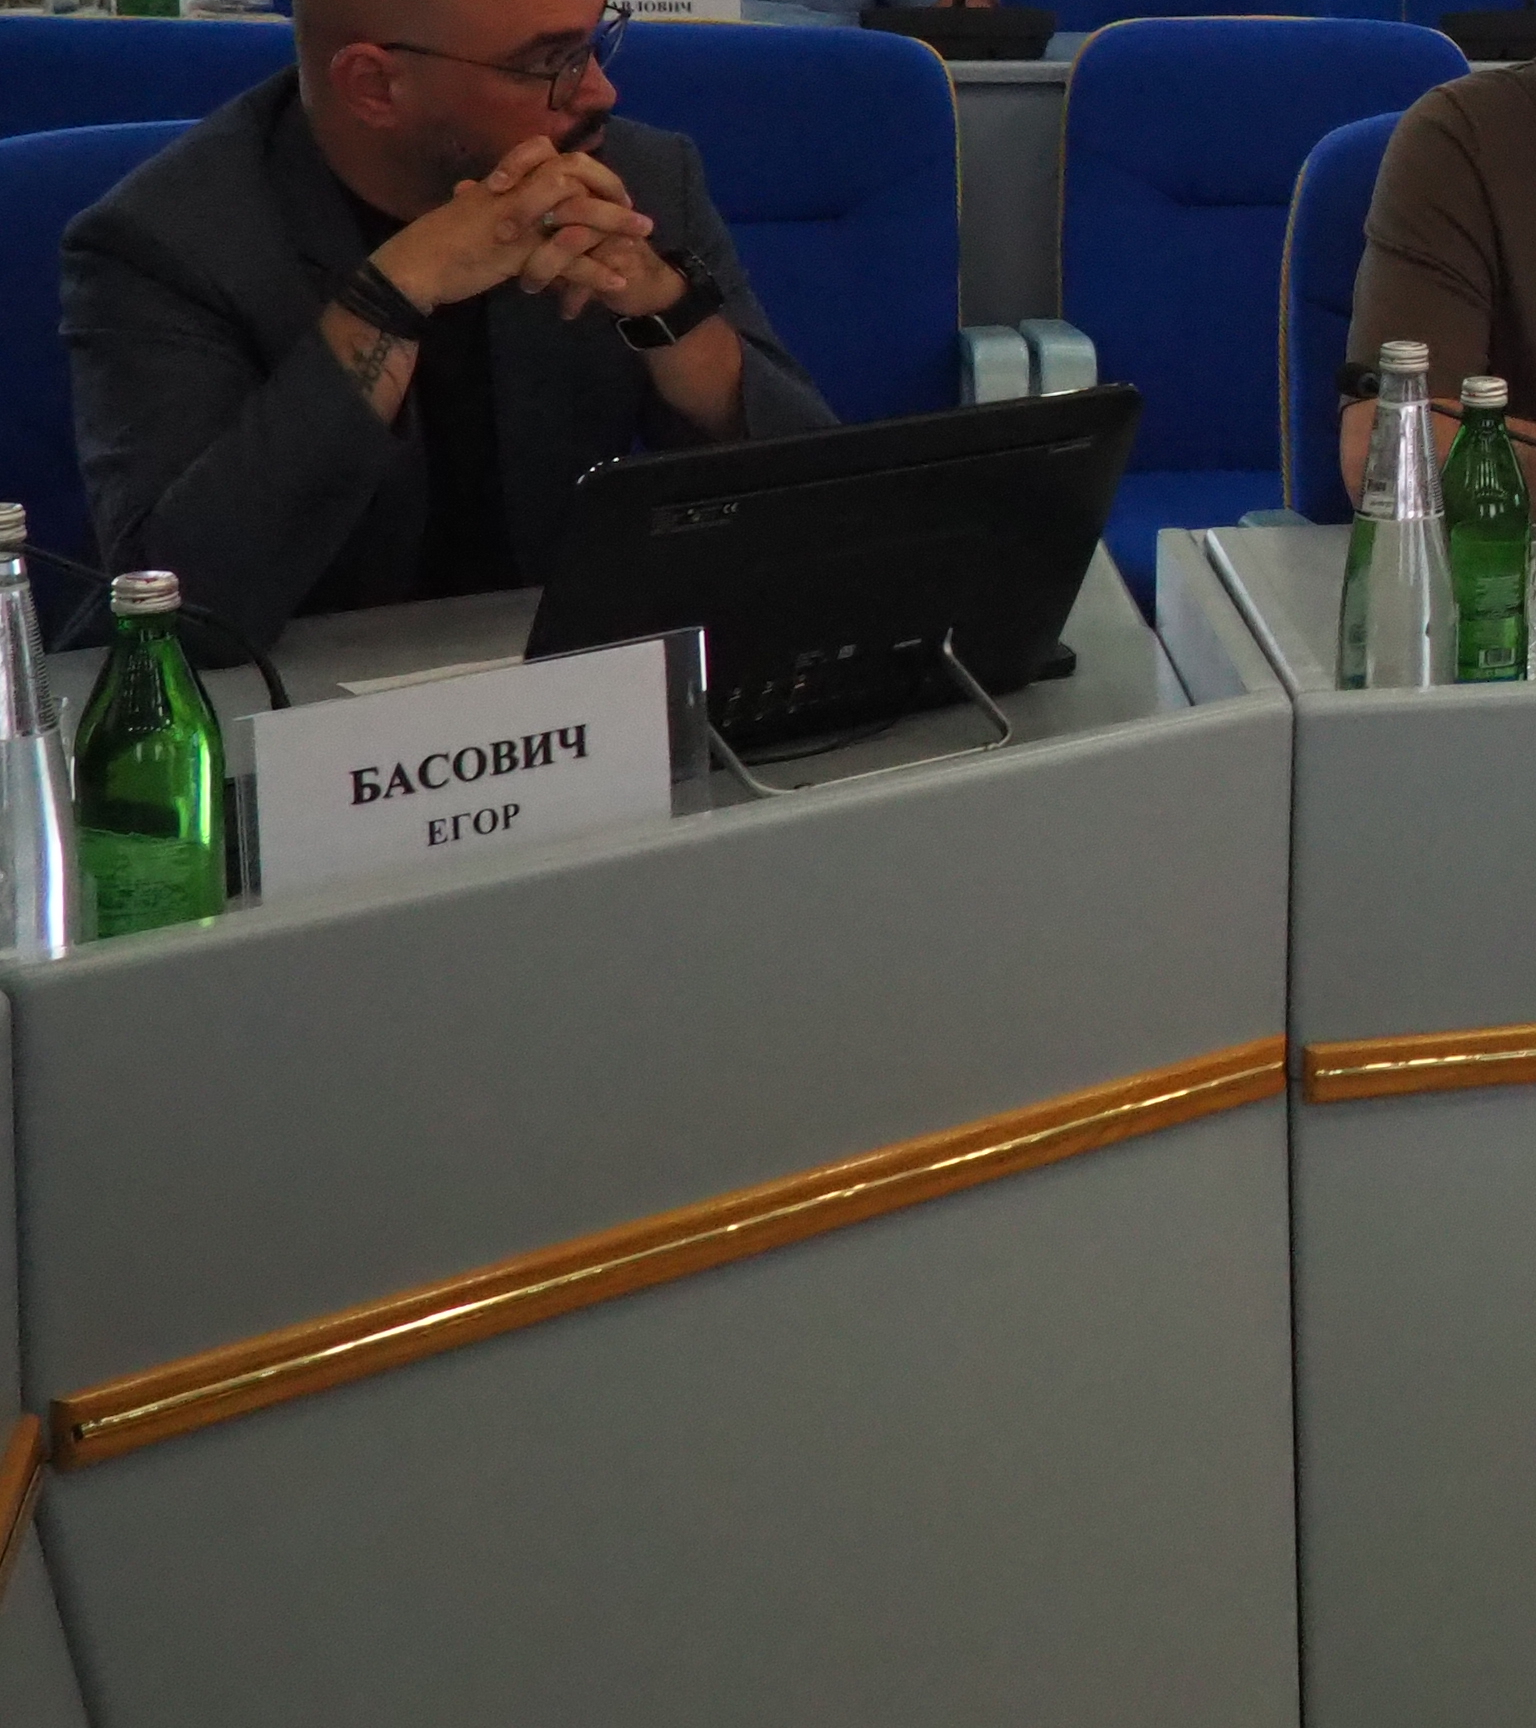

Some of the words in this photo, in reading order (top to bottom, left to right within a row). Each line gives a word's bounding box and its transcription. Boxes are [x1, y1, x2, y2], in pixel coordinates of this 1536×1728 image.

[607, 0, 692, 13] АВЛОВИЧ
[349, 724, 589, 805] БАСОВИЧ
[427, 803, 521, 847] ЕГОР
